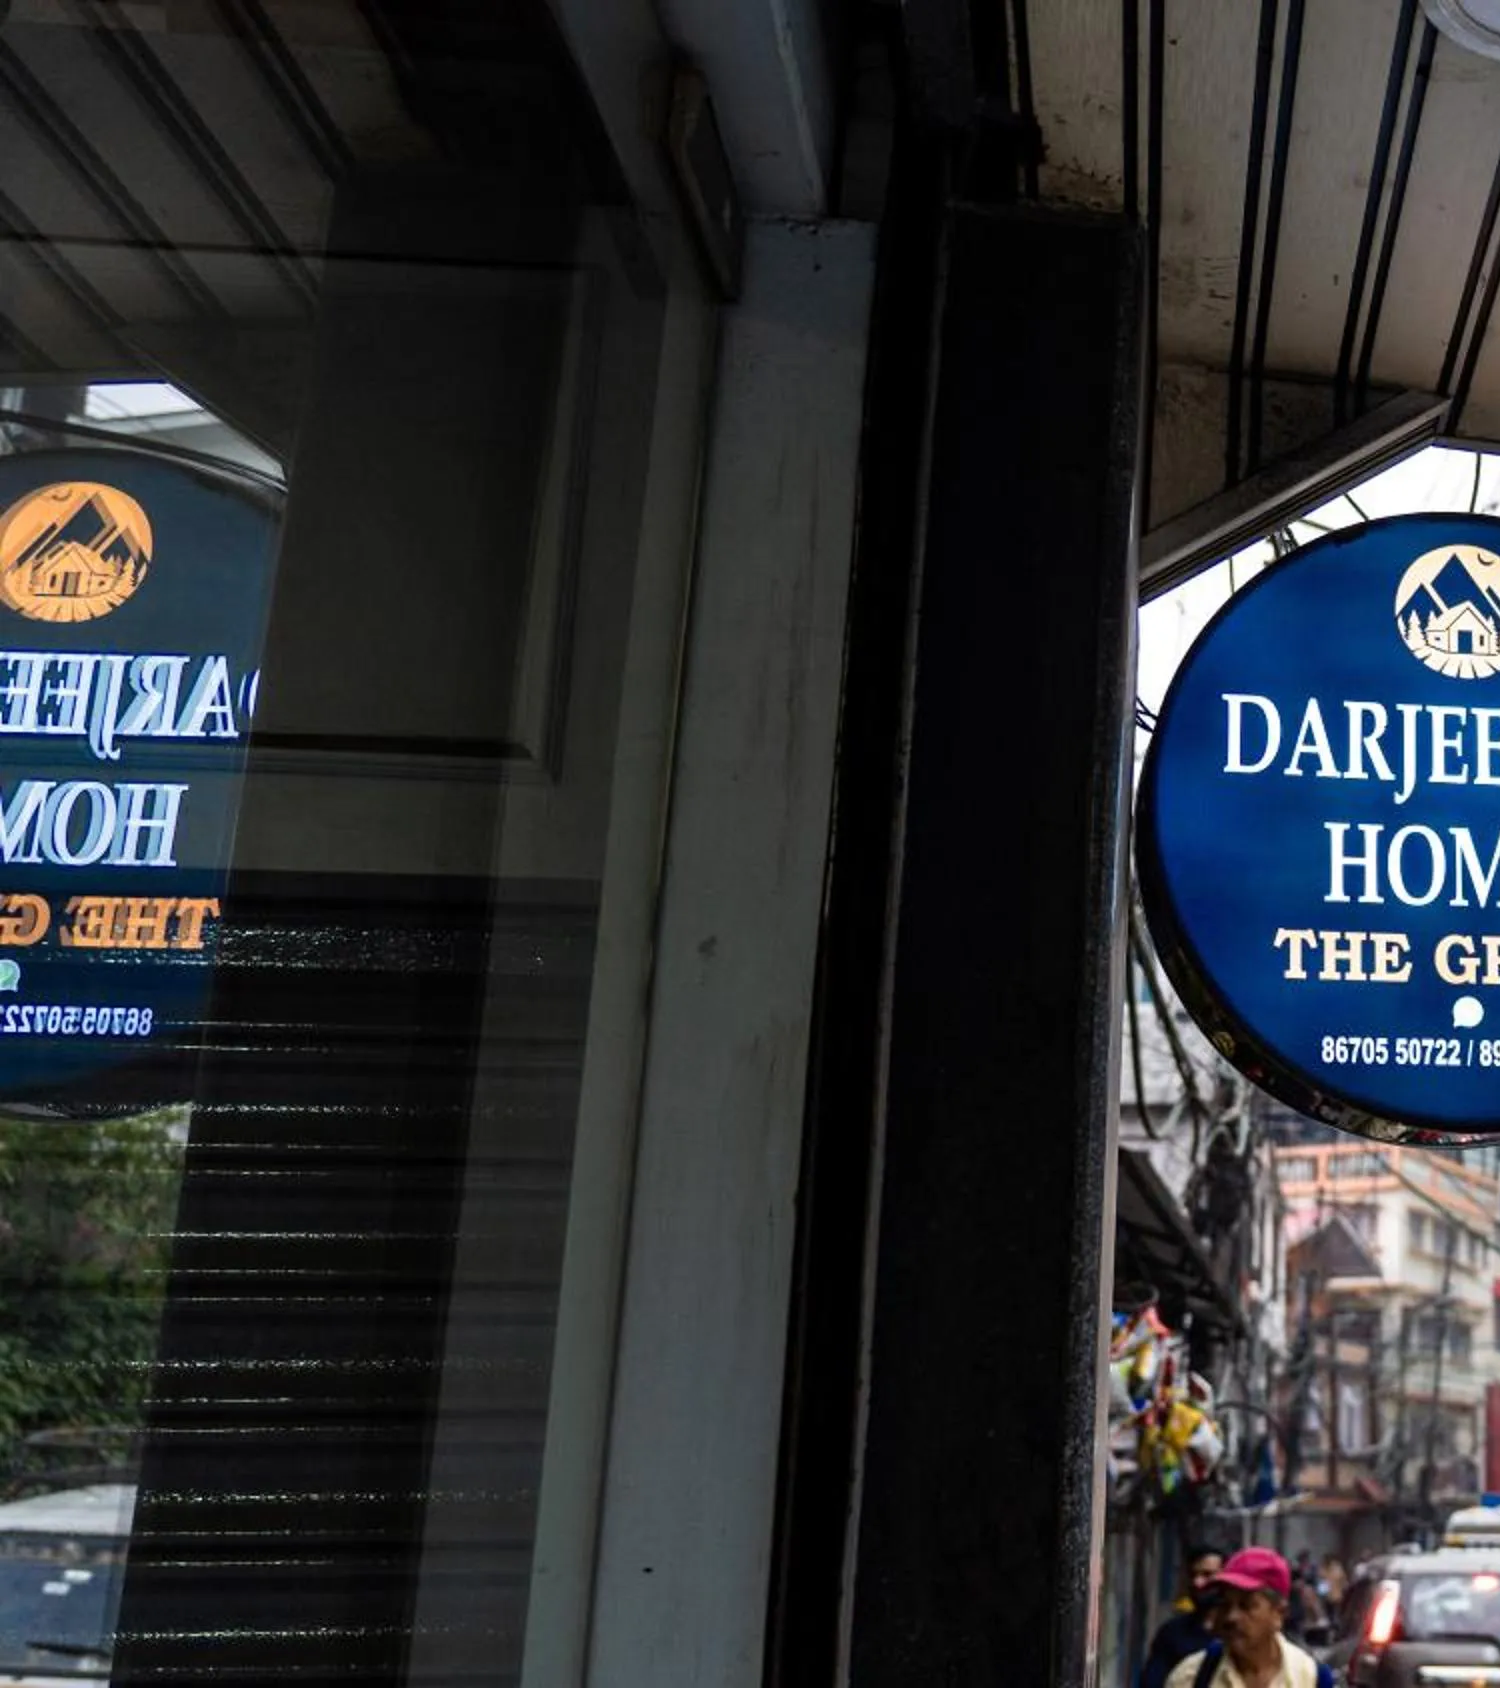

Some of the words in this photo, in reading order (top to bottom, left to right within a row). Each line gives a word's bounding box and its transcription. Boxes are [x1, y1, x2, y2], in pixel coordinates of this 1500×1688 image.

[1273, 927, 1413, 984] THE
[1321, 1036, 1389, 1066] 86705
[1395, 1038, 1461, 1067] 50722
